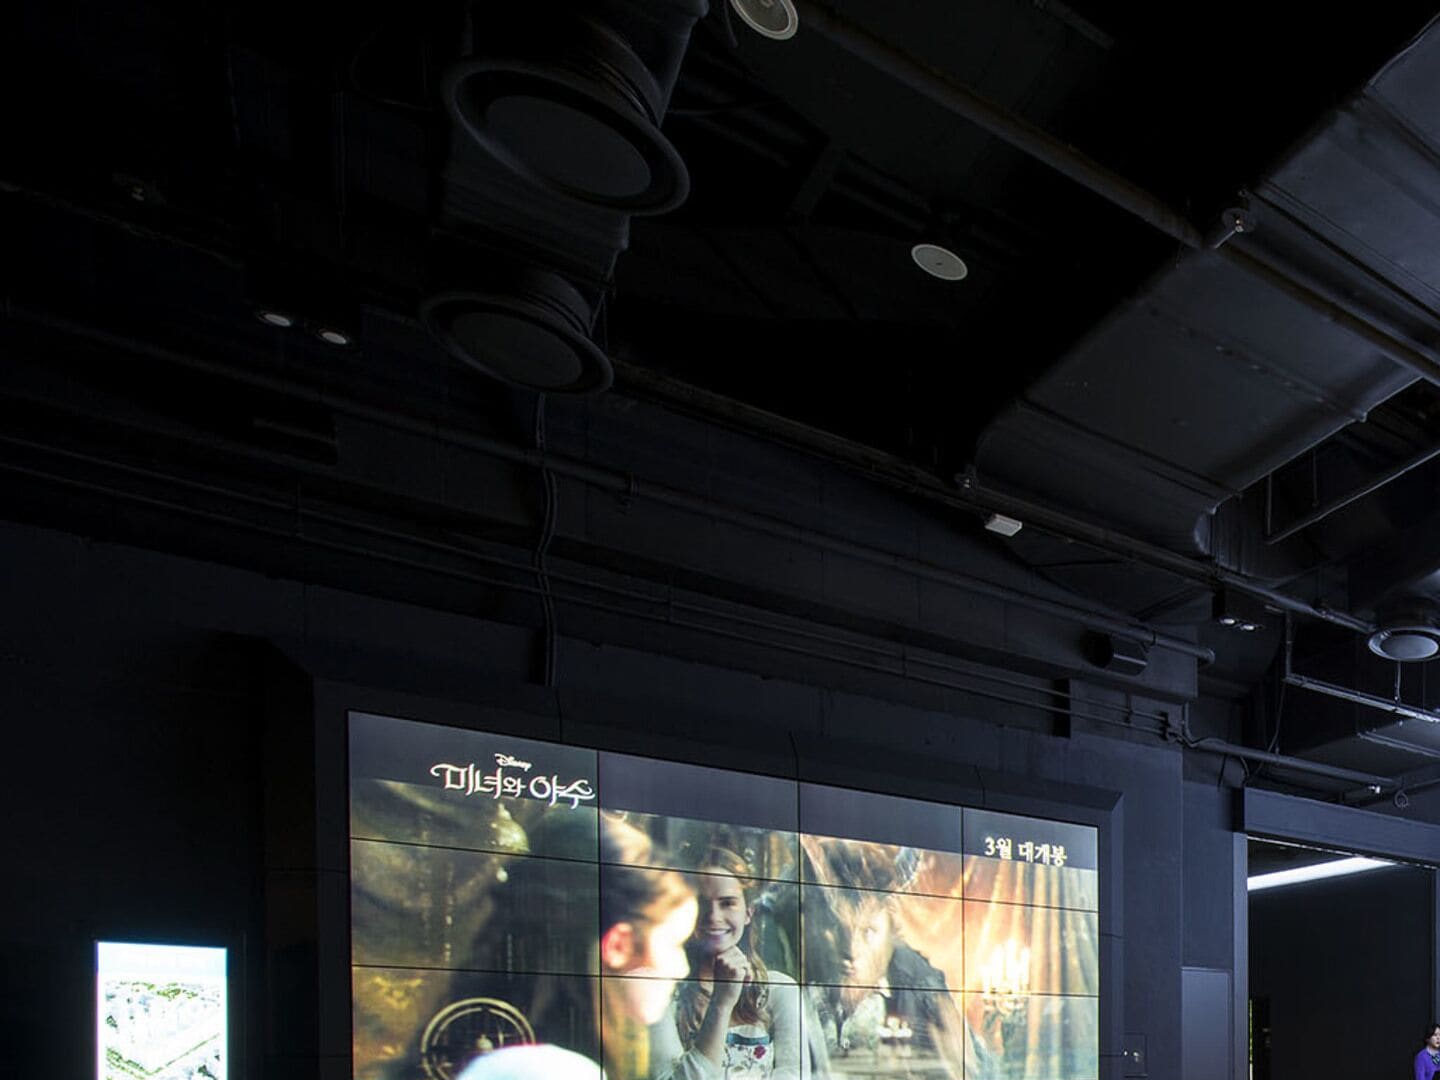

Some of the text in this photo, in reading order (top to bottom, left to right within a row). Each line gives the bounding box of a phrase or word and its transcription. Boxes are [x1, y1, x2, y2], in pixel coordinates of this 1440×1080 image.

[494, 753, 532, 772] Disney
[430, 763, 596, 810] 미녀와 야수
[984, 836, 1068, 868] 3월 대개봉
